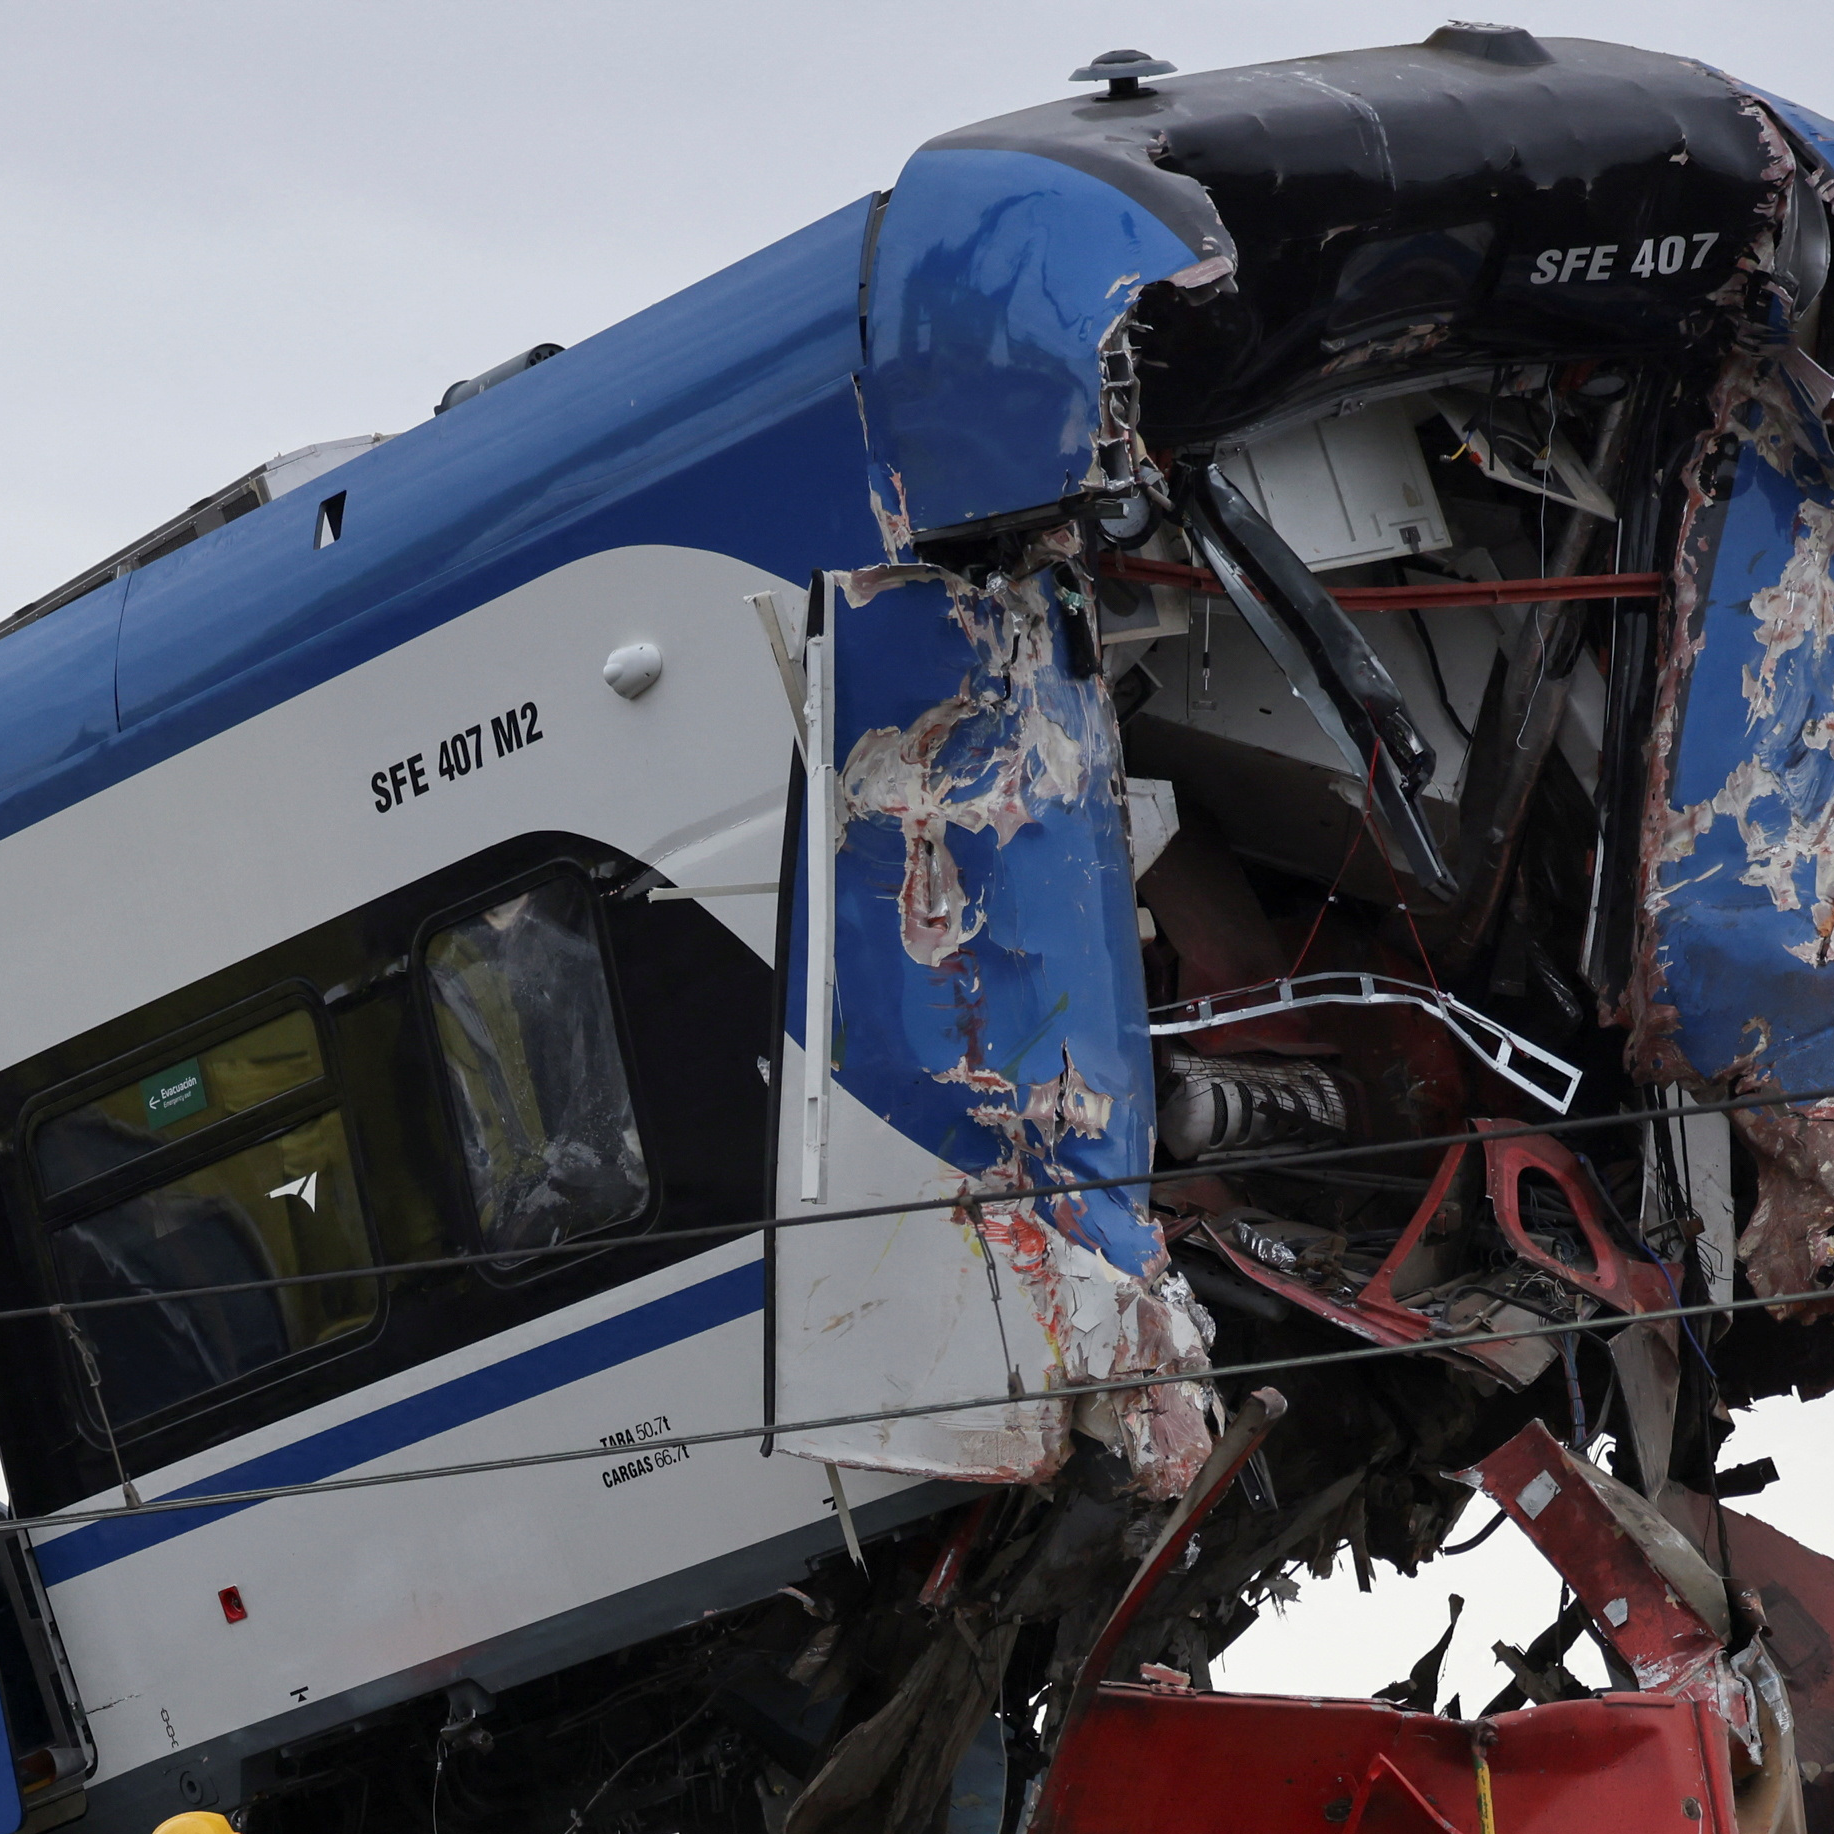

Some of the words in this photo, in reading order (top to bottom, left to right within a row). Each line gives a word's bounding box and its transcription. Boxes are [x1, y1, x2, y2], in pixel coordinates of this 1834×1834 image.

[1530, 249, 1618, 284] SFE
[1630, 232, 1719, 278] 407
[371, 753, 430, 813] SFE
[438, 724, 484, 782] 407
[490, 701, 544, 758] M2
[160, 1076, 197, 1099] Evacuación
[599, 1428, 636, 1448] TARA
[635, 1415, 671, 1441] 50.7t
[602, 1455, 654, 1488] CARGAS
[654, 1443, 690, 1468] 66.7t
